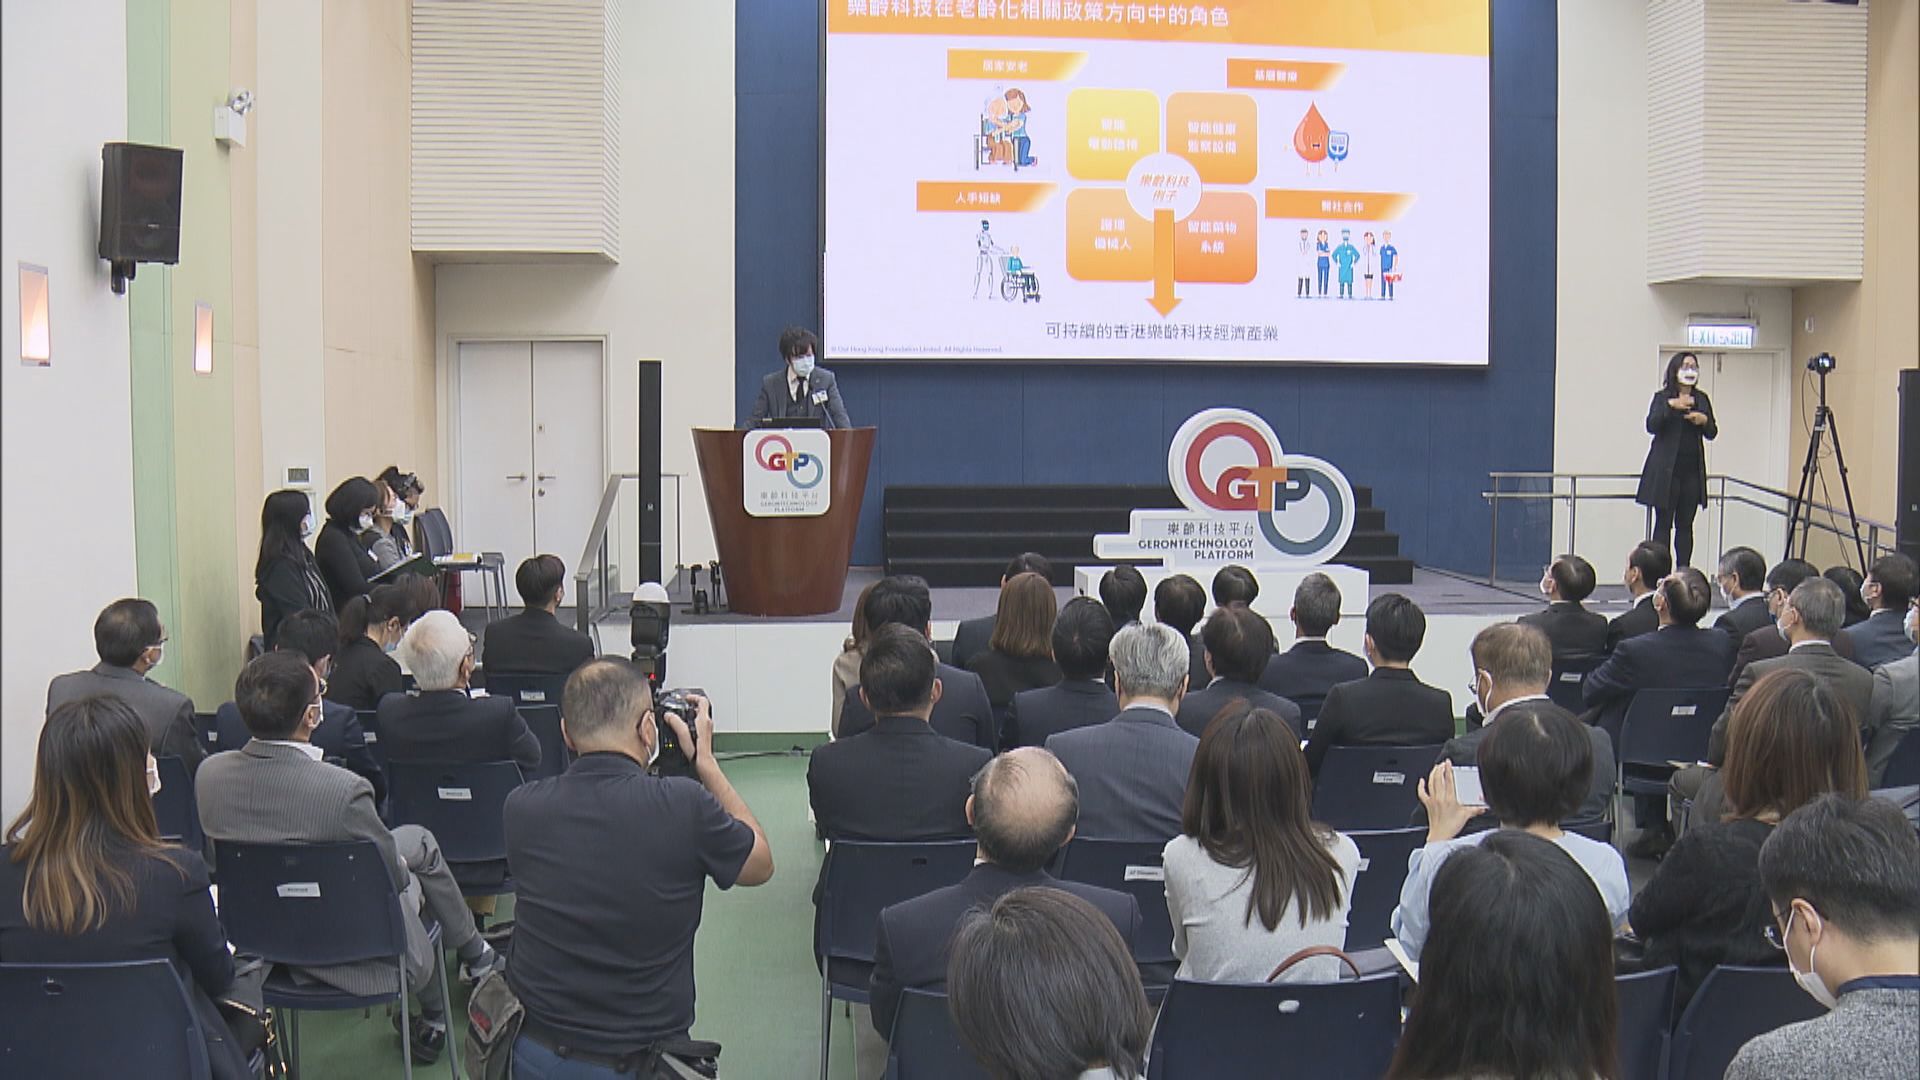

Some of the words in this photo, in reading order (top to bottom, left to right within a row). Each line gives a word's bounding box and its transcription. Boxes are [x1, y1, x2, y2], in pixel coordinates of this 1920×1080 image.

[1045, 321, 1279, 341] 可持續的香港樂齡科技經濟產業
[1216, 466, 1311, 511] GTP
[1167, 521, 1255, 536] 樂齡科技平台
[1138, 539, 1254, 550] GERONTECHNOLOGY
[1194, 550, 1254, 560] PLATFORM
